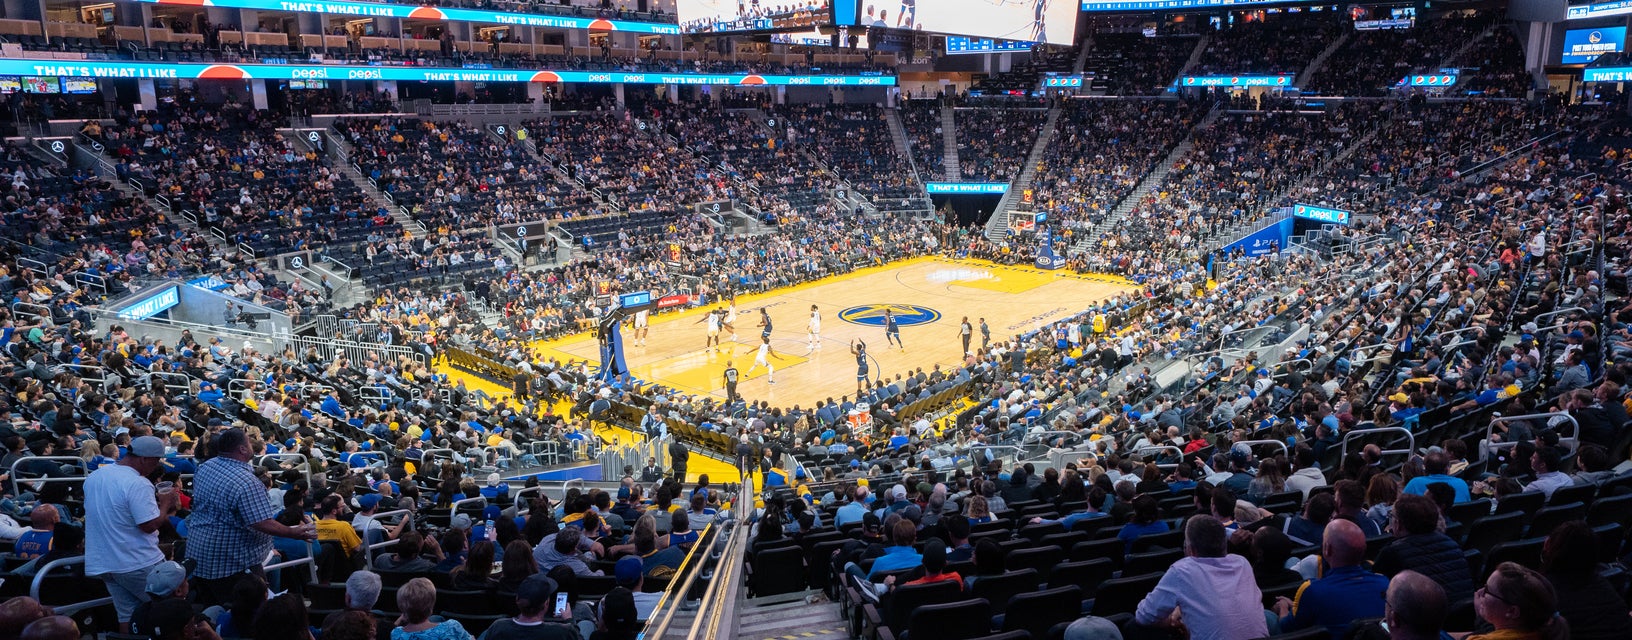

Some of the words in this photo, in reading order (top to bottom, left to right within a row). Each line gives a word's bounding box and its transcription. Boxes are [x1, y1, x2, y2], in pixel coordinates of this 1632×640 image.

[281, 2, 324, 13] THAT'S
[326, 4, 360, 15] WHAT
[363, 7, 368, 15] I
[369, 7, 394, 16] LIKE
[495, 15, 526, 25] THAT'S
[527, 17, 553, 27] WHAT
[554, 19, 558, 27] I
[559, 19, 577, 28] LIKE
[651, 26, 675, 34] THAT'S
[34, 65, 90, 77] THAT'S
[93, 66, 137, 78] WHAT
[140, 68, 145, 78] I
[148, 68, 177, 78] LIKE
[292, 67, 328, 79] pepsi
[348, 68, 382, 80] pepsi
[1592, 71, 1624, 82] THAT'S
[424, 72, 460, 81] THAT'S
[461, 73, 490, 81] WHAT
[492, 73, 496, 81] I
[498, 74, 518, 82] LIKE
[588, 73, 611, 83] pepsi
[623, 73, 645, 83] pepsi
[661, 76, 686, 84] THAT'S
[788, 76, 811, 85] pepsi
[823, 76, 846, 85] pepsi
[858, 76, 881, 85] pepsi
[1201, 77, 1223, 86] pepsi
[1246, 77, 1269, 86] pepsi
[1309, 208, 1333, 220] pepsi
[130, 301, 154, 318] WHAT
[158, 291, 175, 307] LIKE
